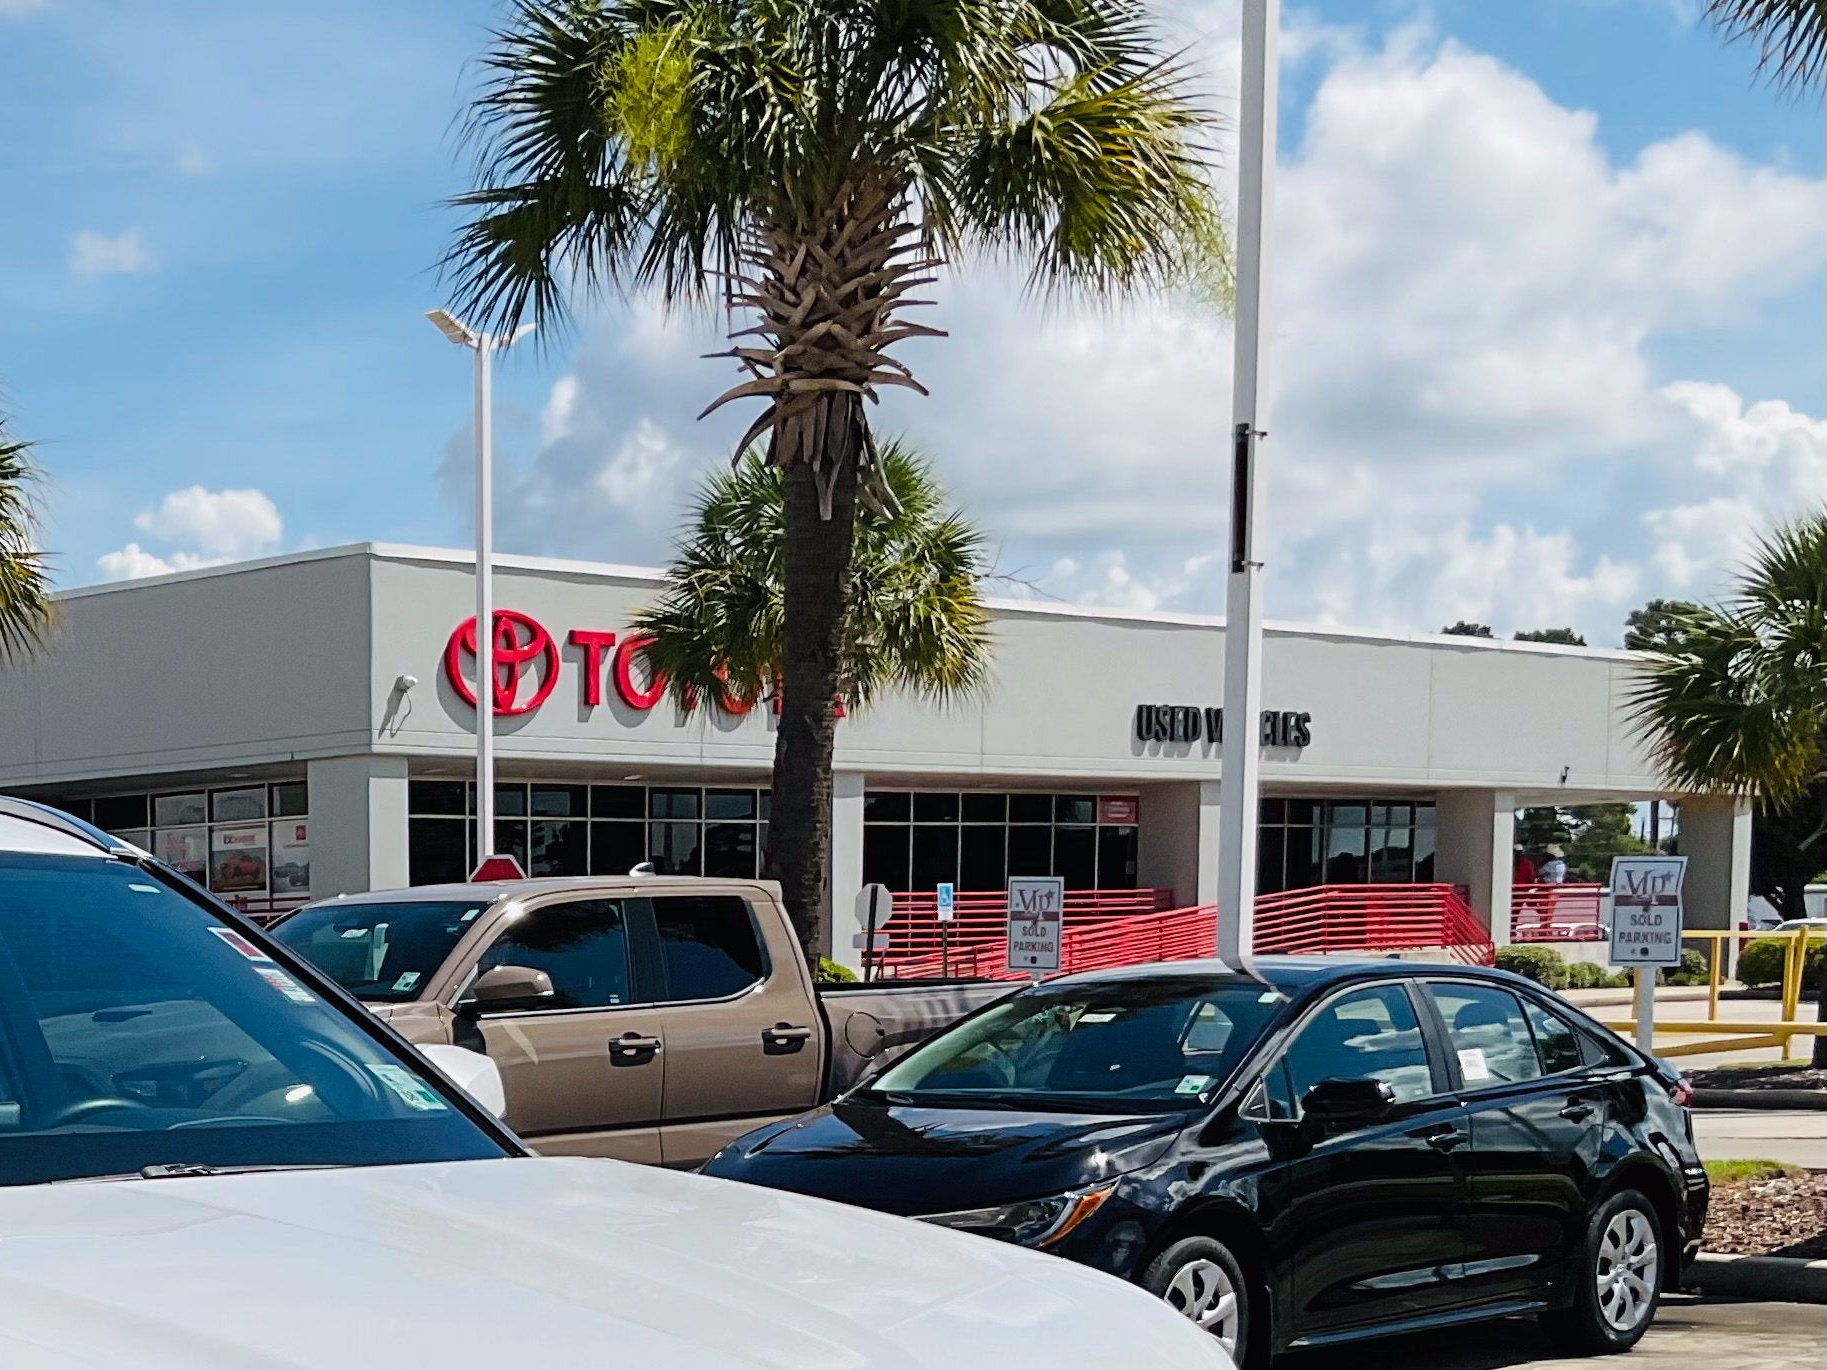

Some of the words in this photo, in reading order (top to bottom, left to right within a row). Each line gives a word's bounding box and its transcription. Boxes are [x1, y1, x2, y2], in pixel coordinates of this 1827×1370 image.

[1136, 704, 1202, 742] USED
[1205, 706, 1312, 748] VCLES
[1629, 913, 1663, 927] SOLD
[1022, 925, 1047, 937] SOLD
[1618, 931, 1673, 945] PARKING
[1013, 941, 1054, 953] PARKING
